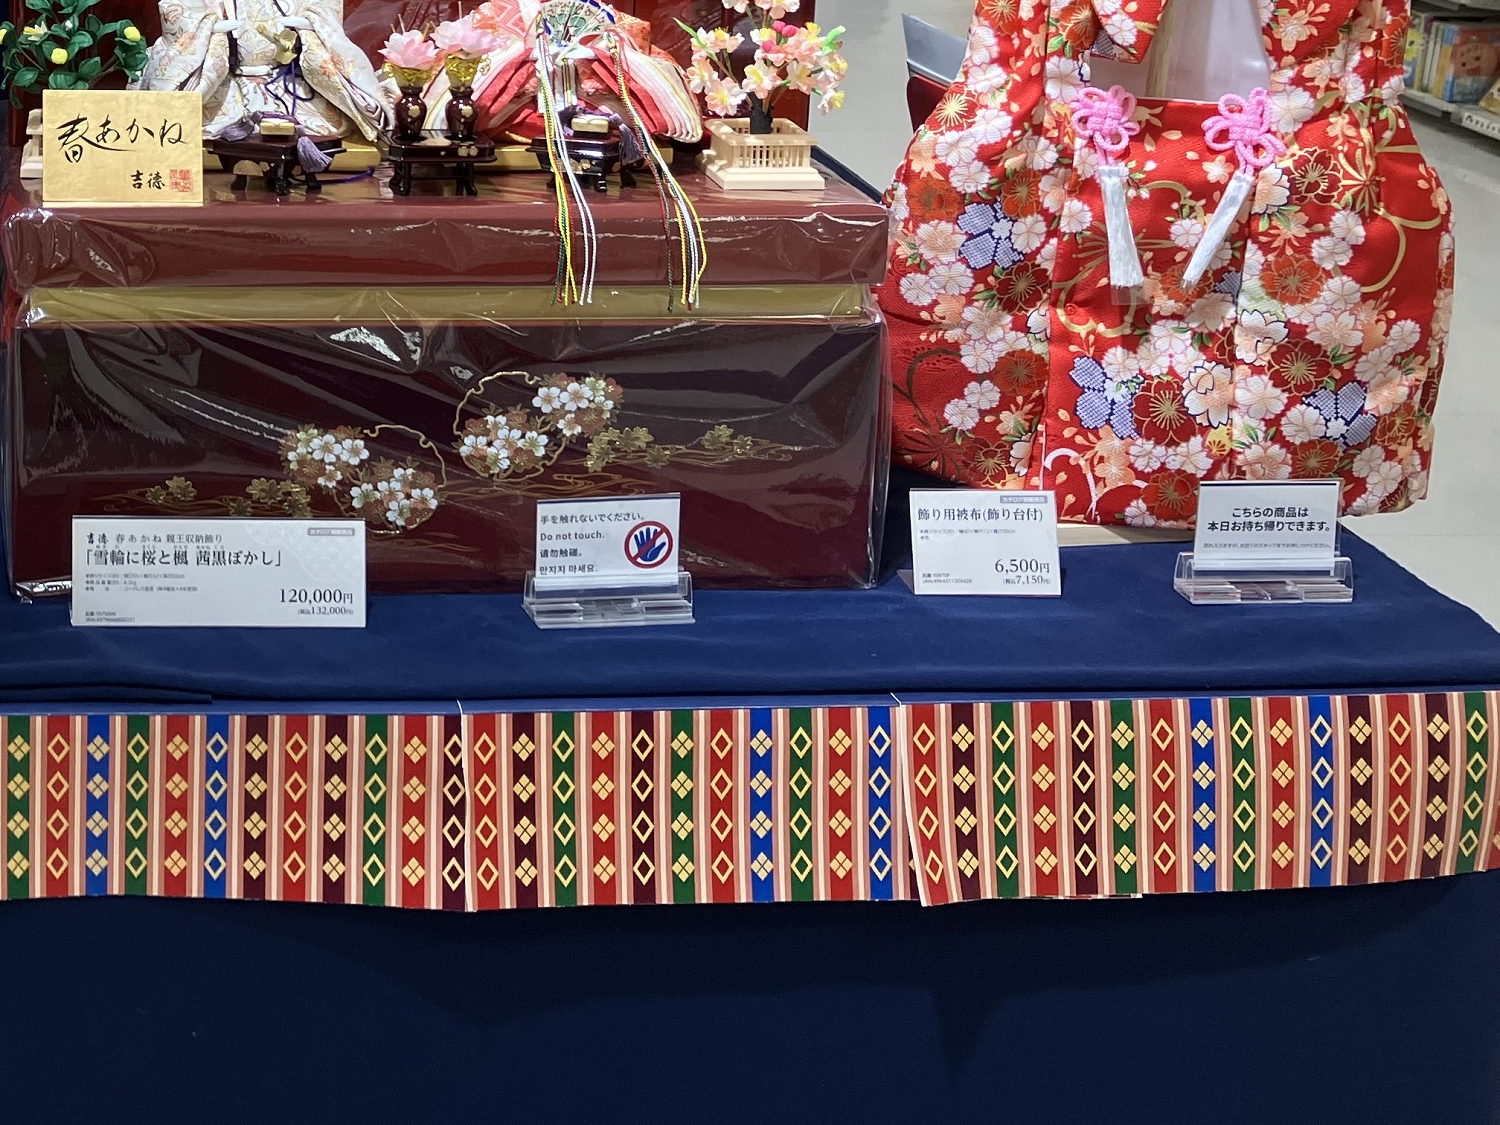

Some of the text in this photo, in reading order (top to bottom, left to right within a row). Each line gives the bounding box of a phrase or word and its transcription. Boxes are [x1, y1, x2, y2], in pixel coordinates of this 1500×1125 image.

[129, 169, 166, 190] 吉徳
[540, 512, 646, 525] 手を触れないでください。
[917, 508, 1044, 522] 飾り用被布(飾り台付)
[1231, 506, 1309, 518] こちらの商品は
[1206, 520, 1331, 532] 本日お持ち帰りできます。
[540, 530, 605, 541] Do not touch.
[995, 559, 1051, 575] 6,500円
[279, 588, 354, 605] 120,000円
